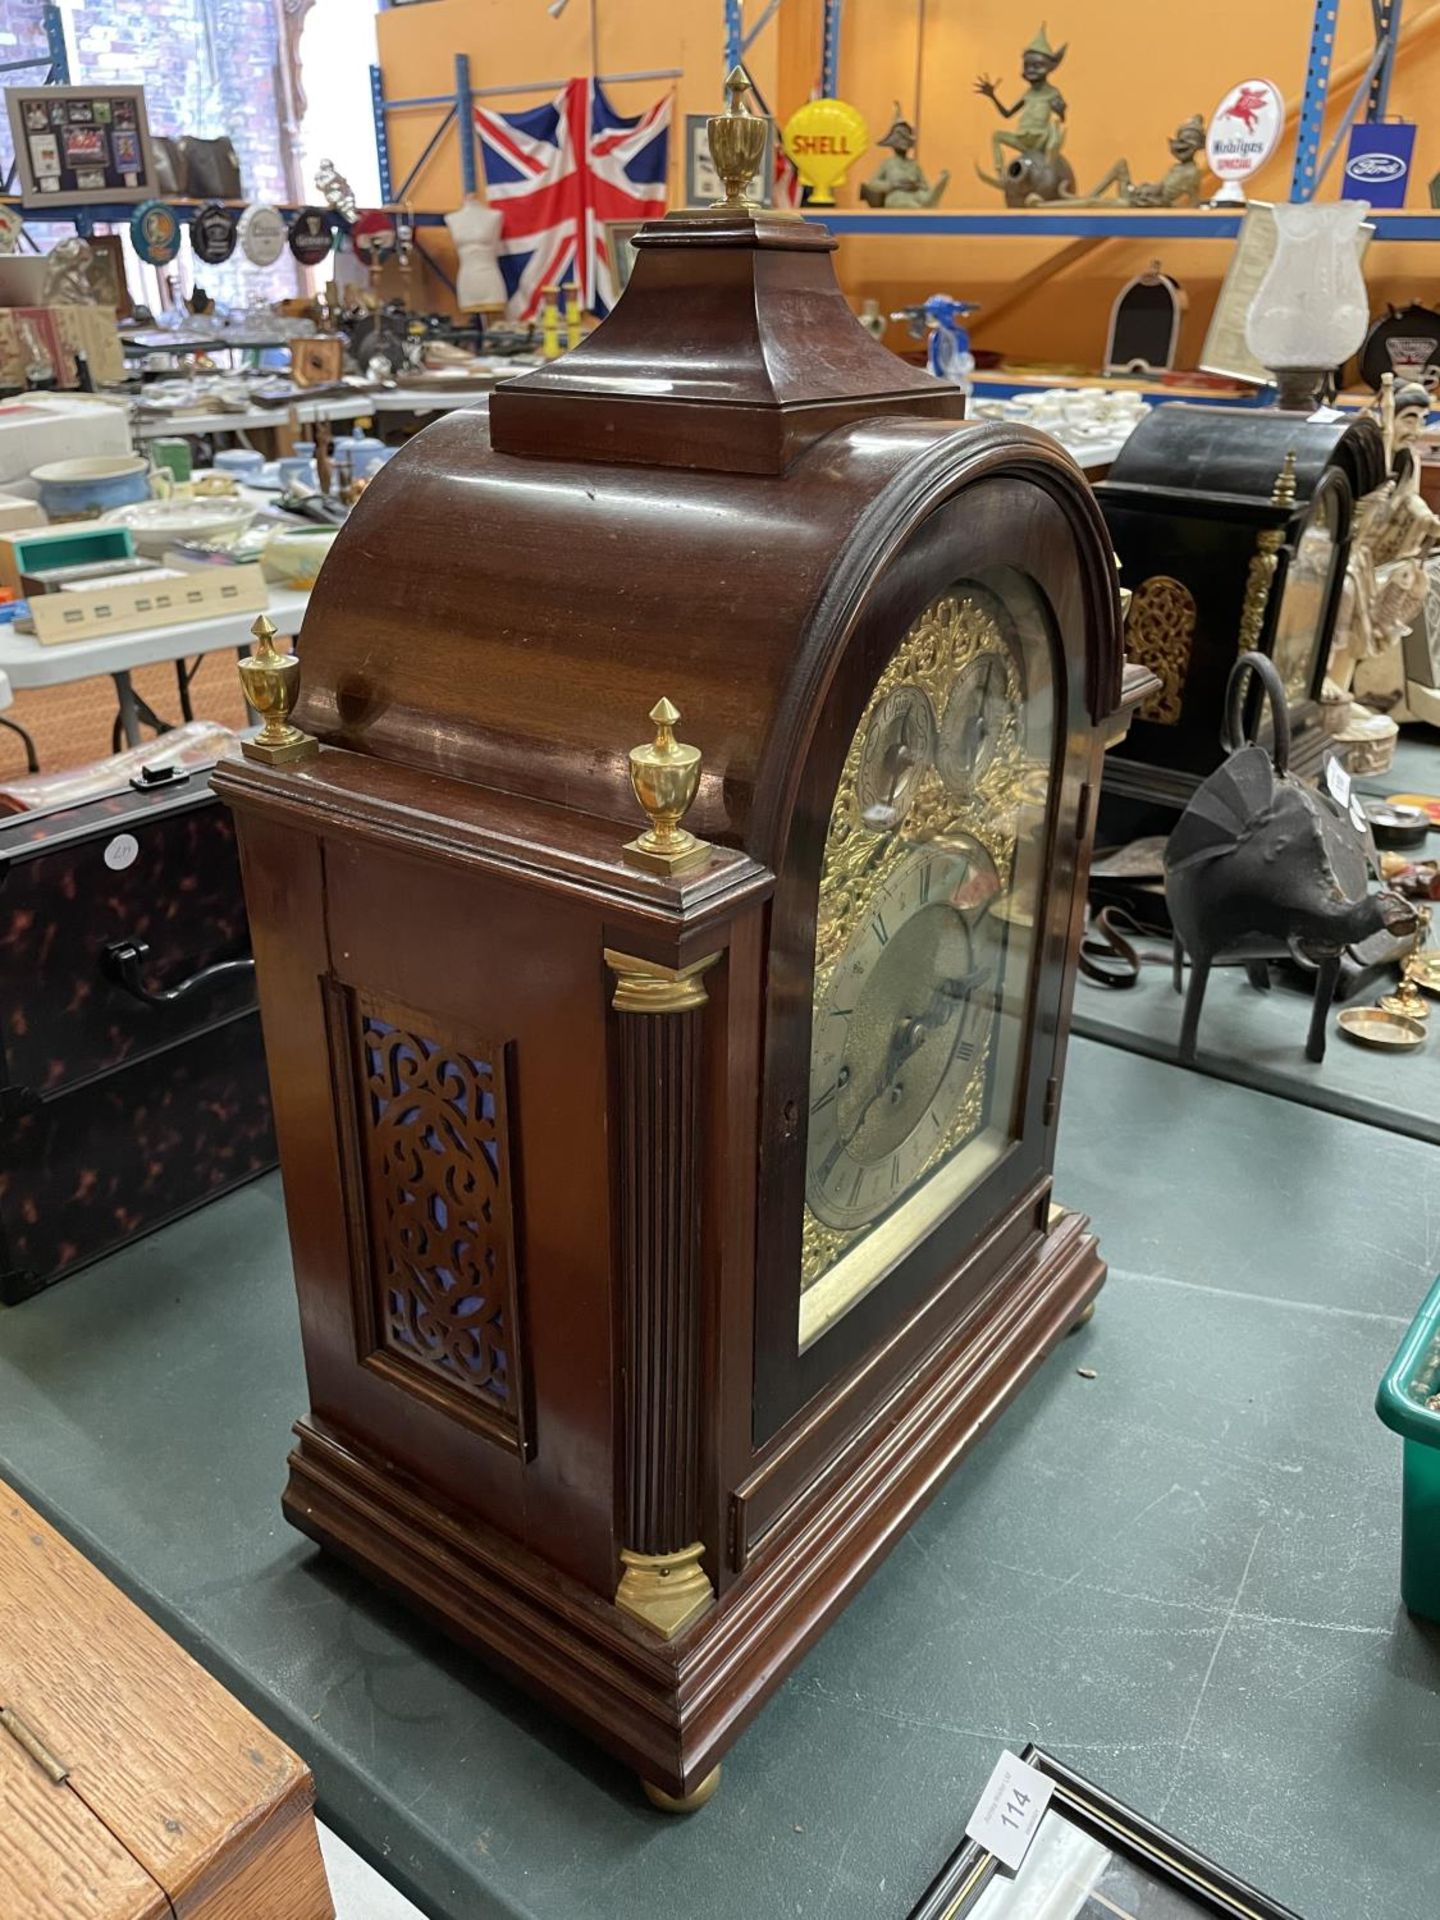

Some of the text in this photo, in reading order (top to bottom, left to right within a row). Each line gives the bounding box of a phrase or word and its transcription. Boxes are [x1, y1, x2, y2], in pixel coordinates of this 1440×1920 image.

[792, 134, 851, 155] SHELL
[1353, 158, 1401, 175] Ford
[1001, 1788, 1031, 1829] 114
